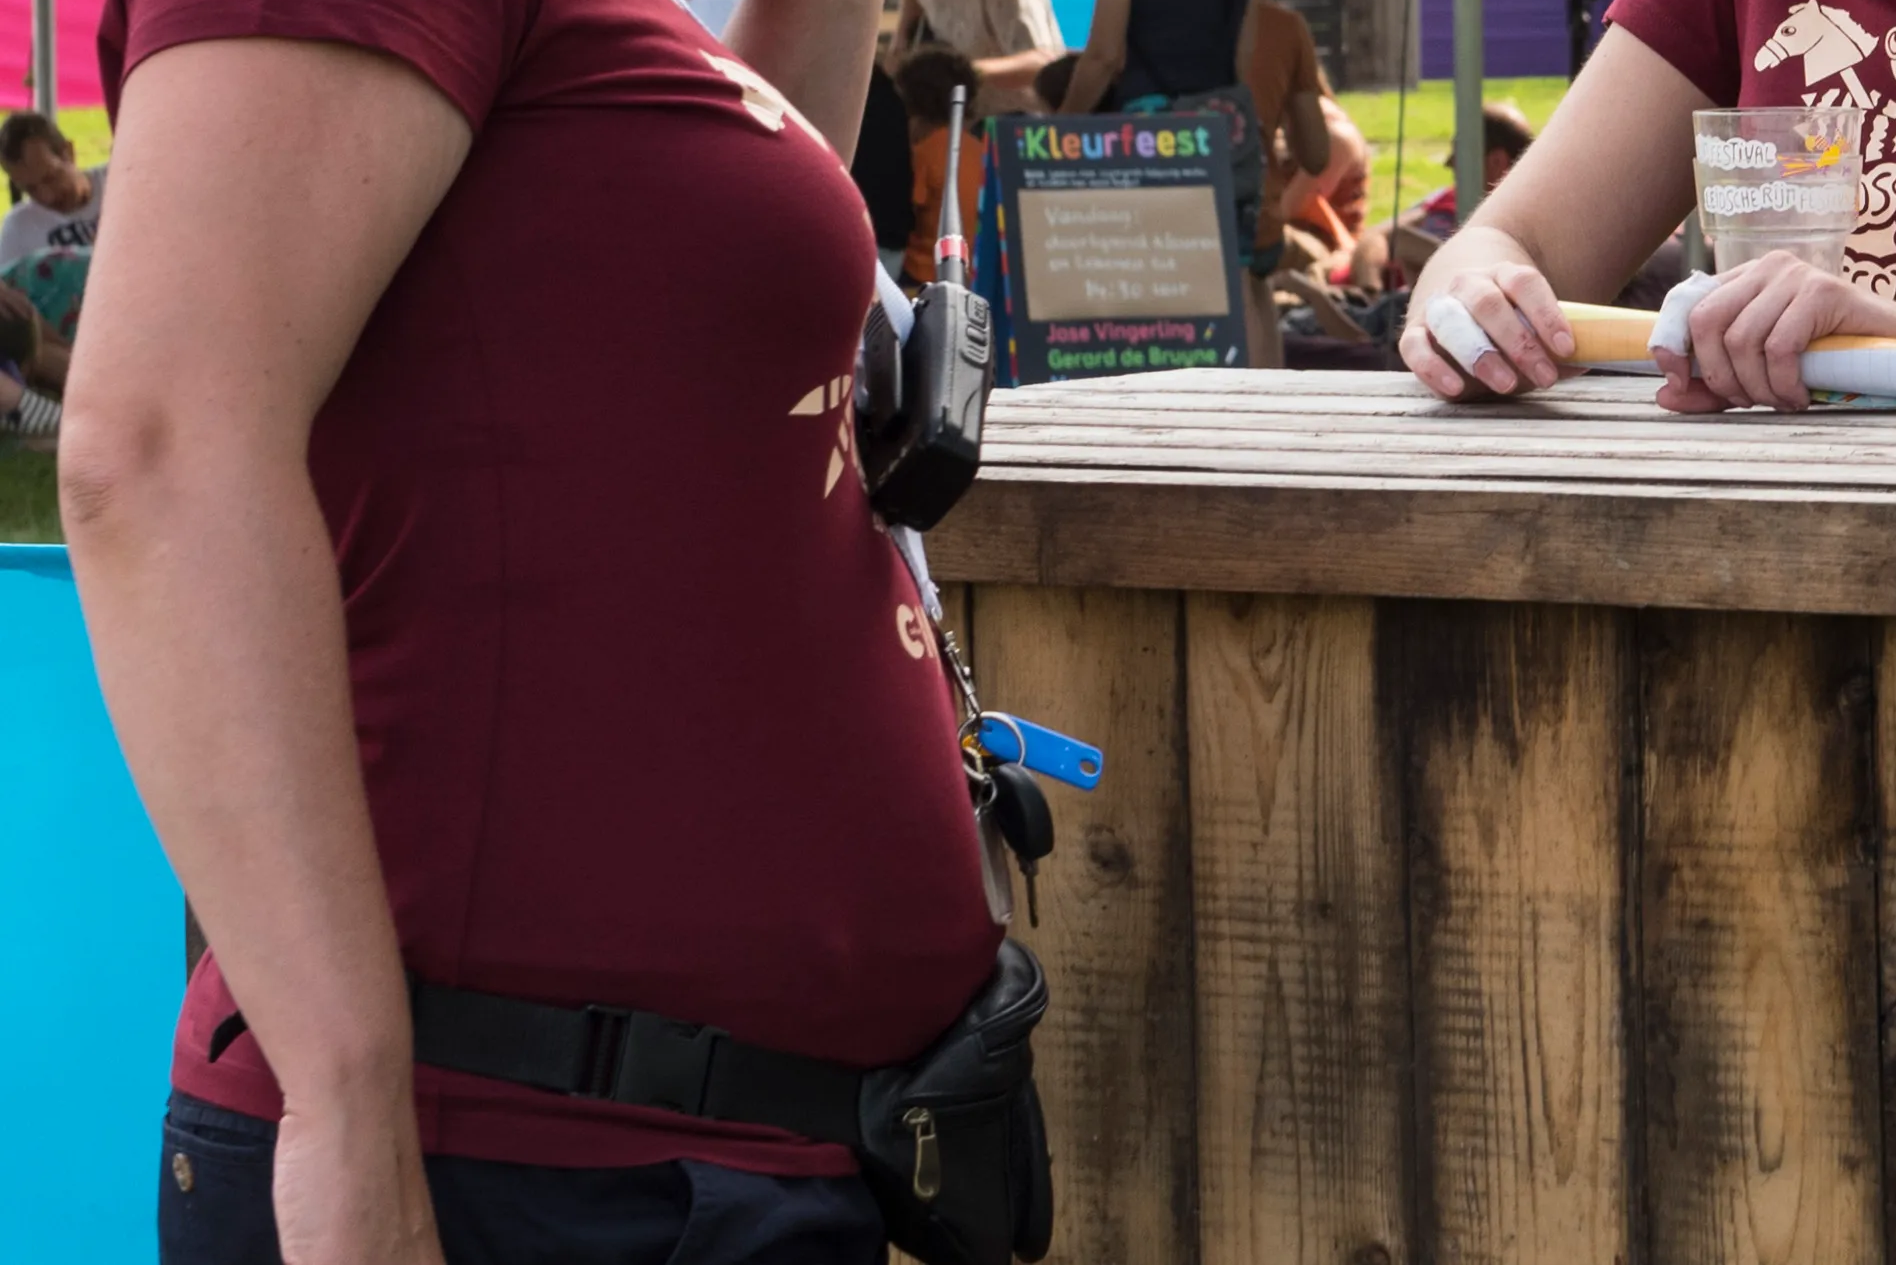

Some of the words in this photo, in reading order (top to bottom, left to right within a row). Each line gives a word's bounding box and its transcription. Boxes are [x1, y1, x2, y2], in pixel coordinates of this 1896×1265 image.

[1024, 123, 1211, 160] Kleurfeest
[1093, 320, 1196, 345] Vingerling
[1047, 348, 1117, 370] Gerard
[1120, 348, 1145, 367] de
